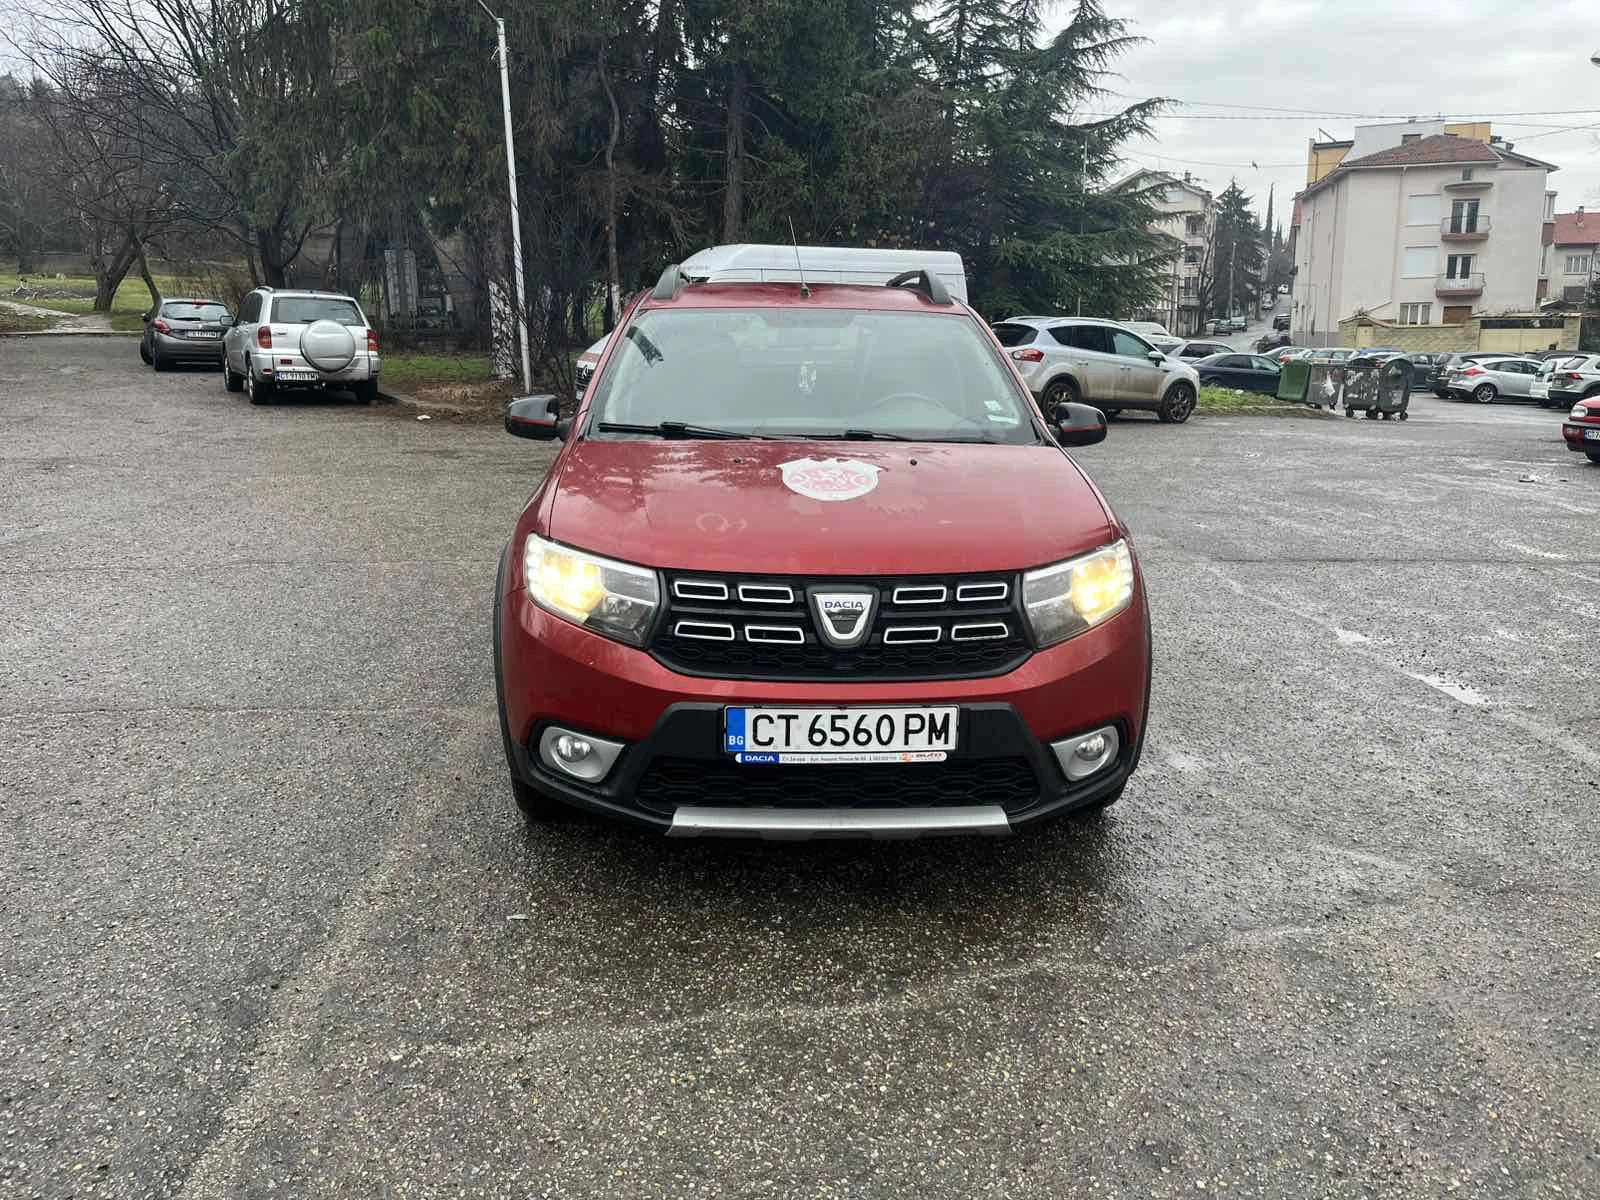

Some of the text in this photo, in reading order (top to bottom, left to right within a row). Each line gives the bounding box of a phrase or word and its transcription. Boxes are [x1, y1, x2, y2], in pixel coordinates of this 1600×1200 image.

[824, 601, 864, 609] DACIA
[752, 713, 950, 747] CT 6560 PM
[728, 735, 744, 746] BG
